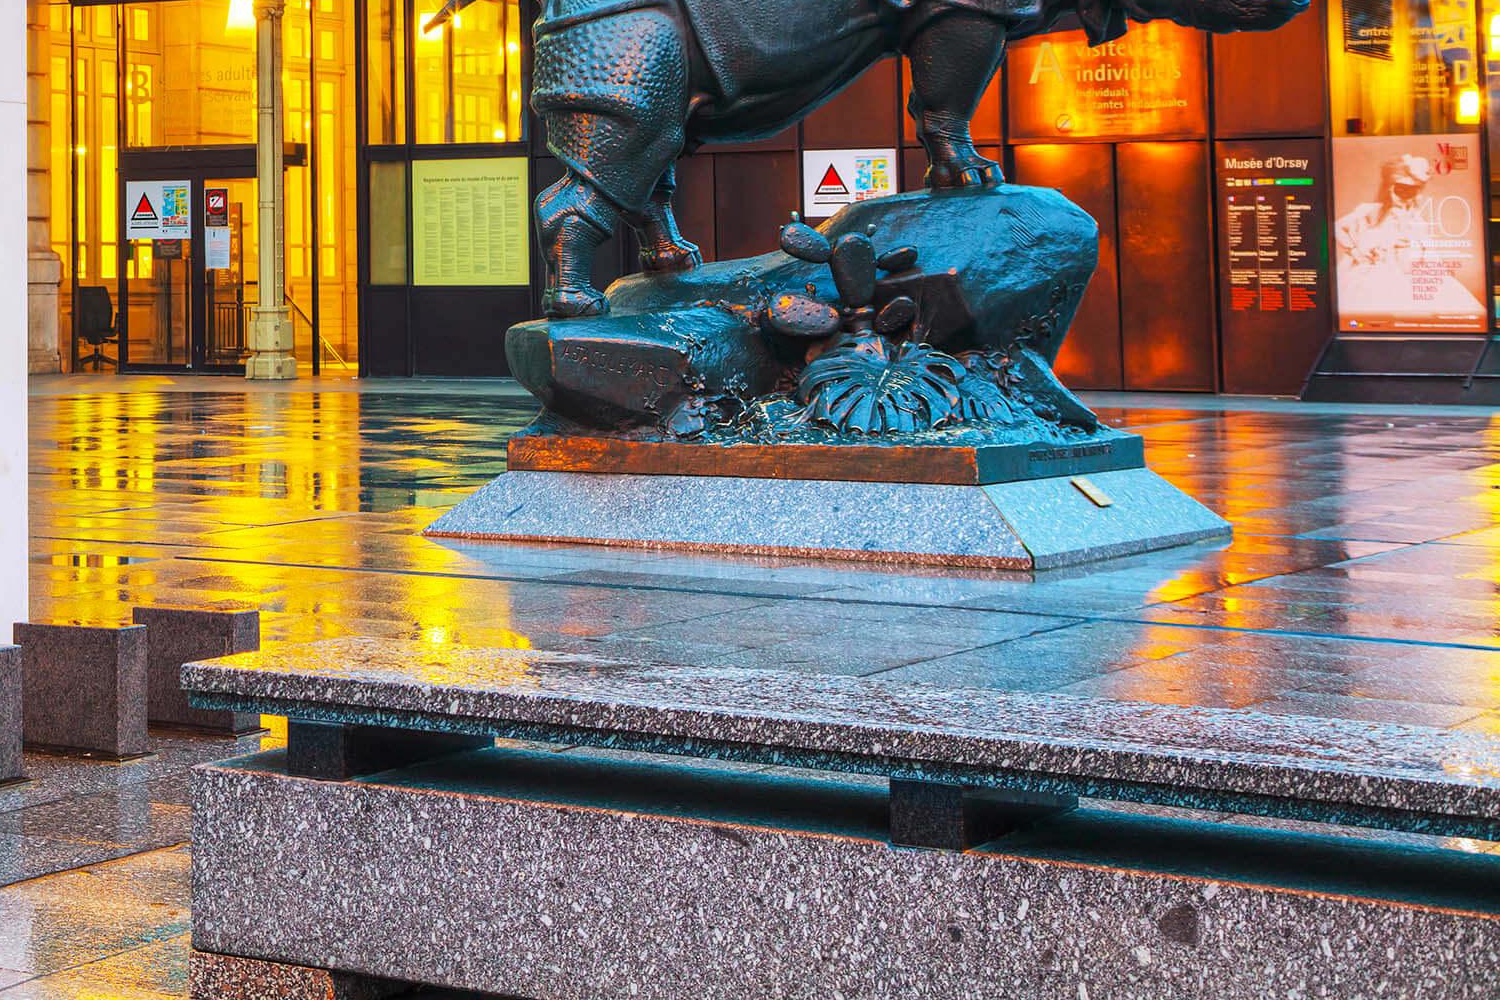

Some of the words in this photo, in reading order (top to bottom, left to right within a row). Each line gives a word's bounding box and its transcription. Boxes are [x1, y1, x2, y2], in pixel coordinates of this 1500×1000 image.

[1029, 42, 1064, 84] A
[1225, 158, 1263, 169] Musée
[1265, 156, 1309, 171] d'Orsay
